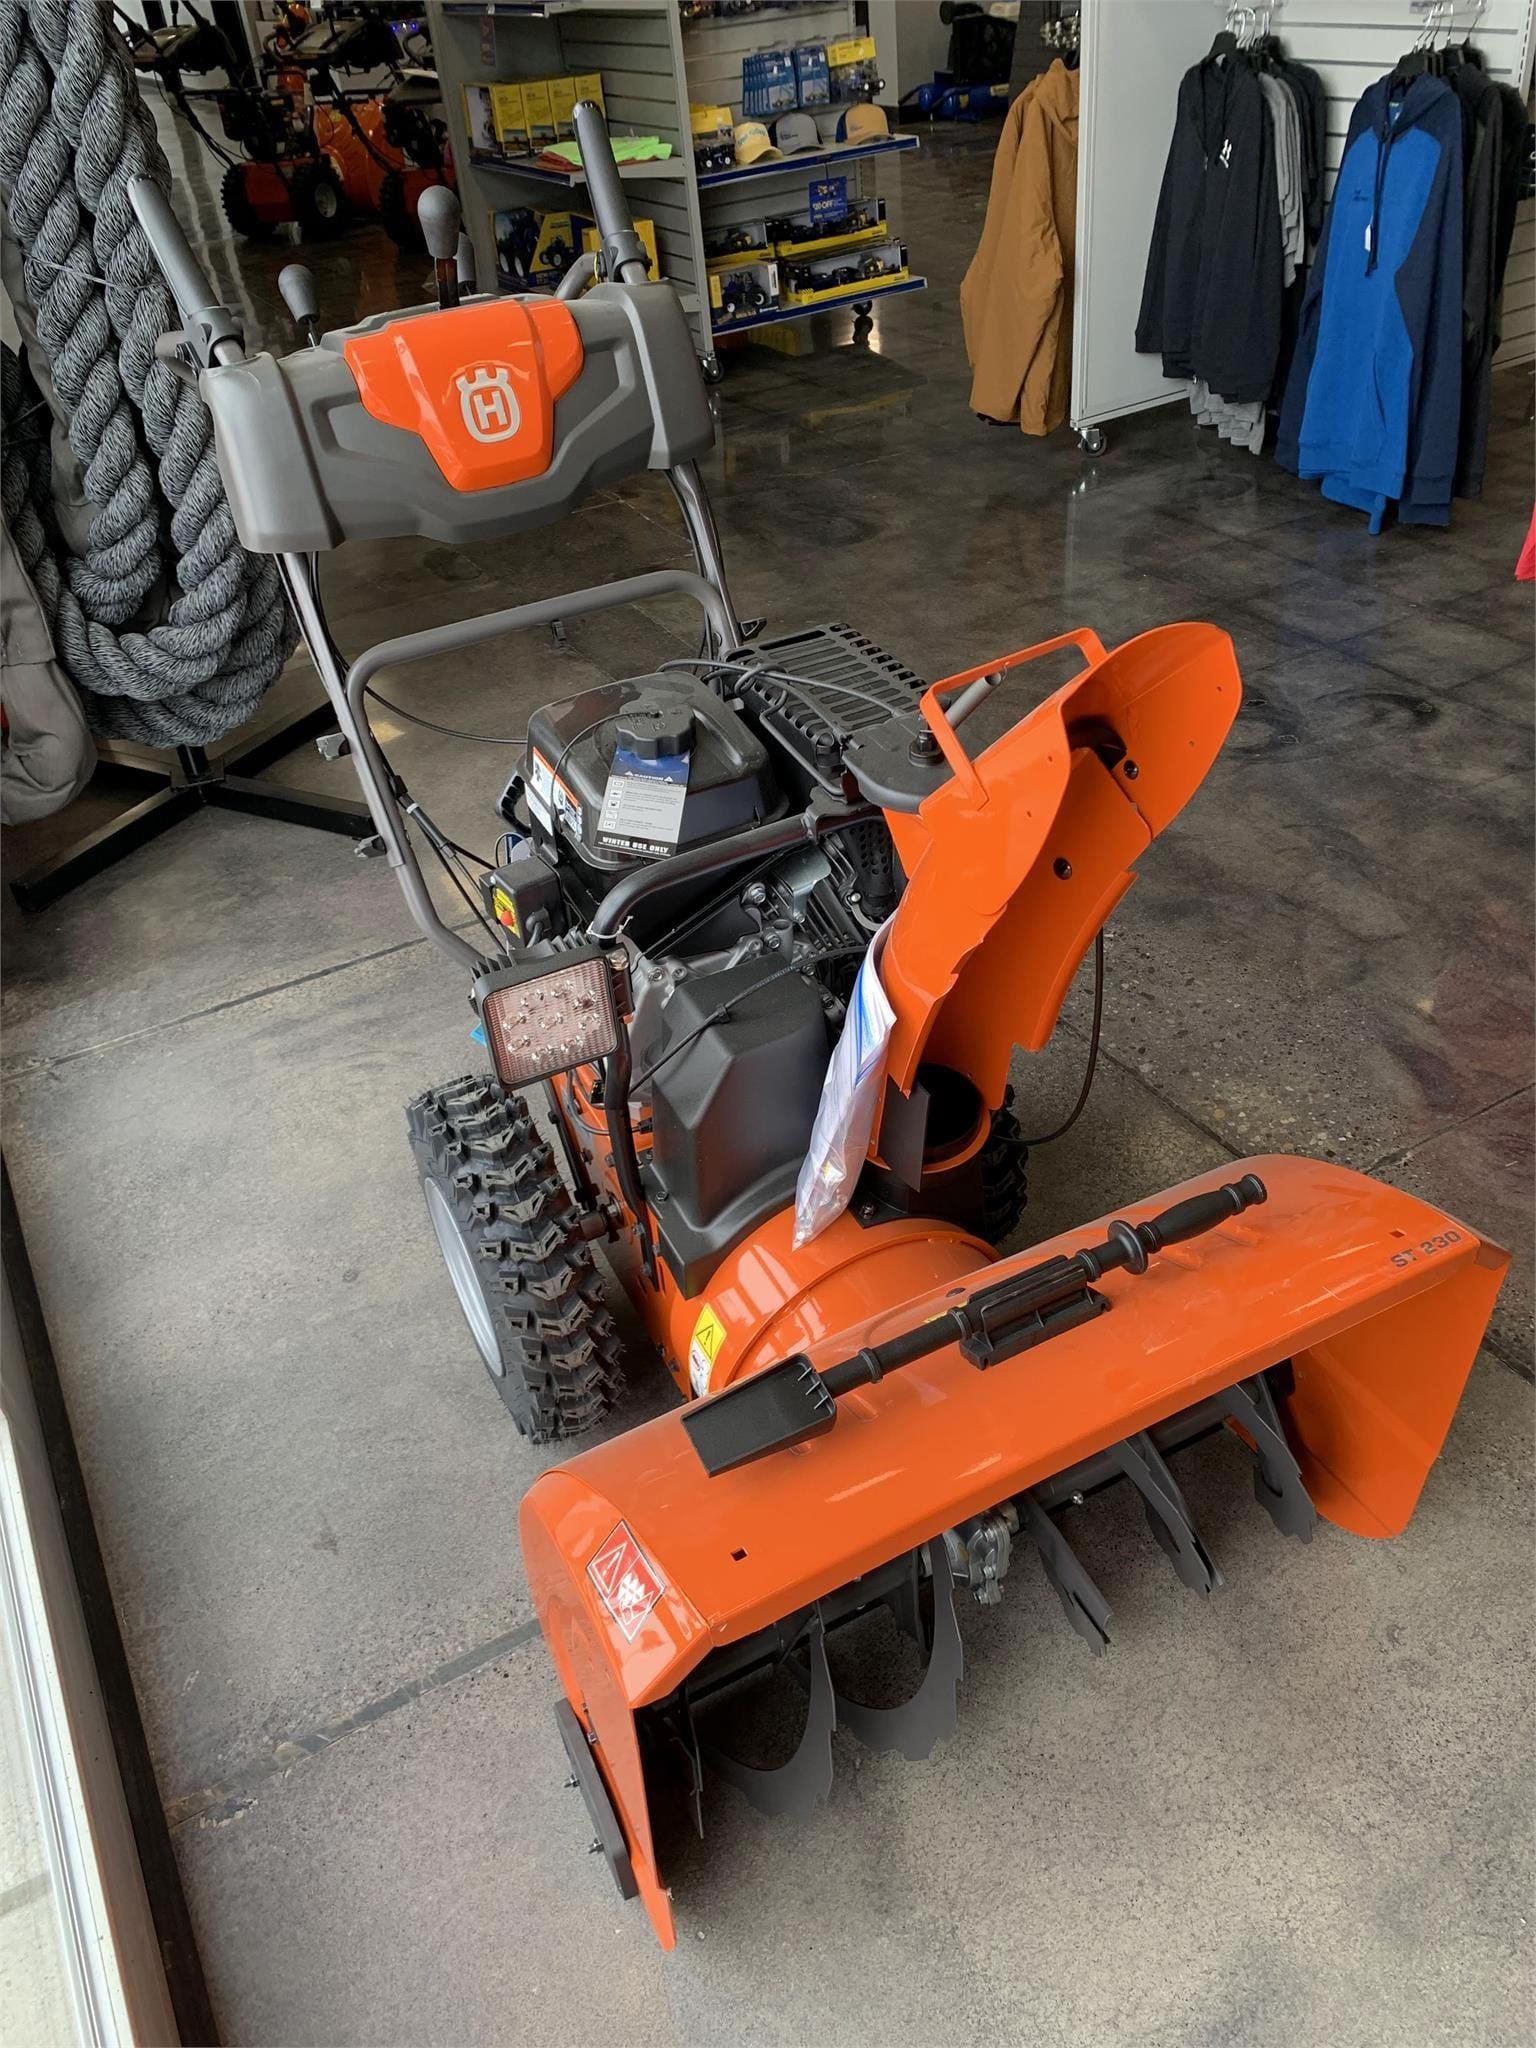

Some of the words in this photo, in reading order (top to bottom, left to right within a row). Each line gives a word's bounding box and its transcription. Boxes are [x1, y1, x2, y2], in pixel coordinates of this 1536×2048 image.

[822, 200, 833, 209] OFF
[473, 390, 508, 430] H
[602, 836, 630, 847] WINTER
[632, 842, 647, 850] USE
[649, 844, 669, 854] ONLY
[1391, 1249, 1417, 1268] ST
[1420, 1231, 1462, 1254] 230
